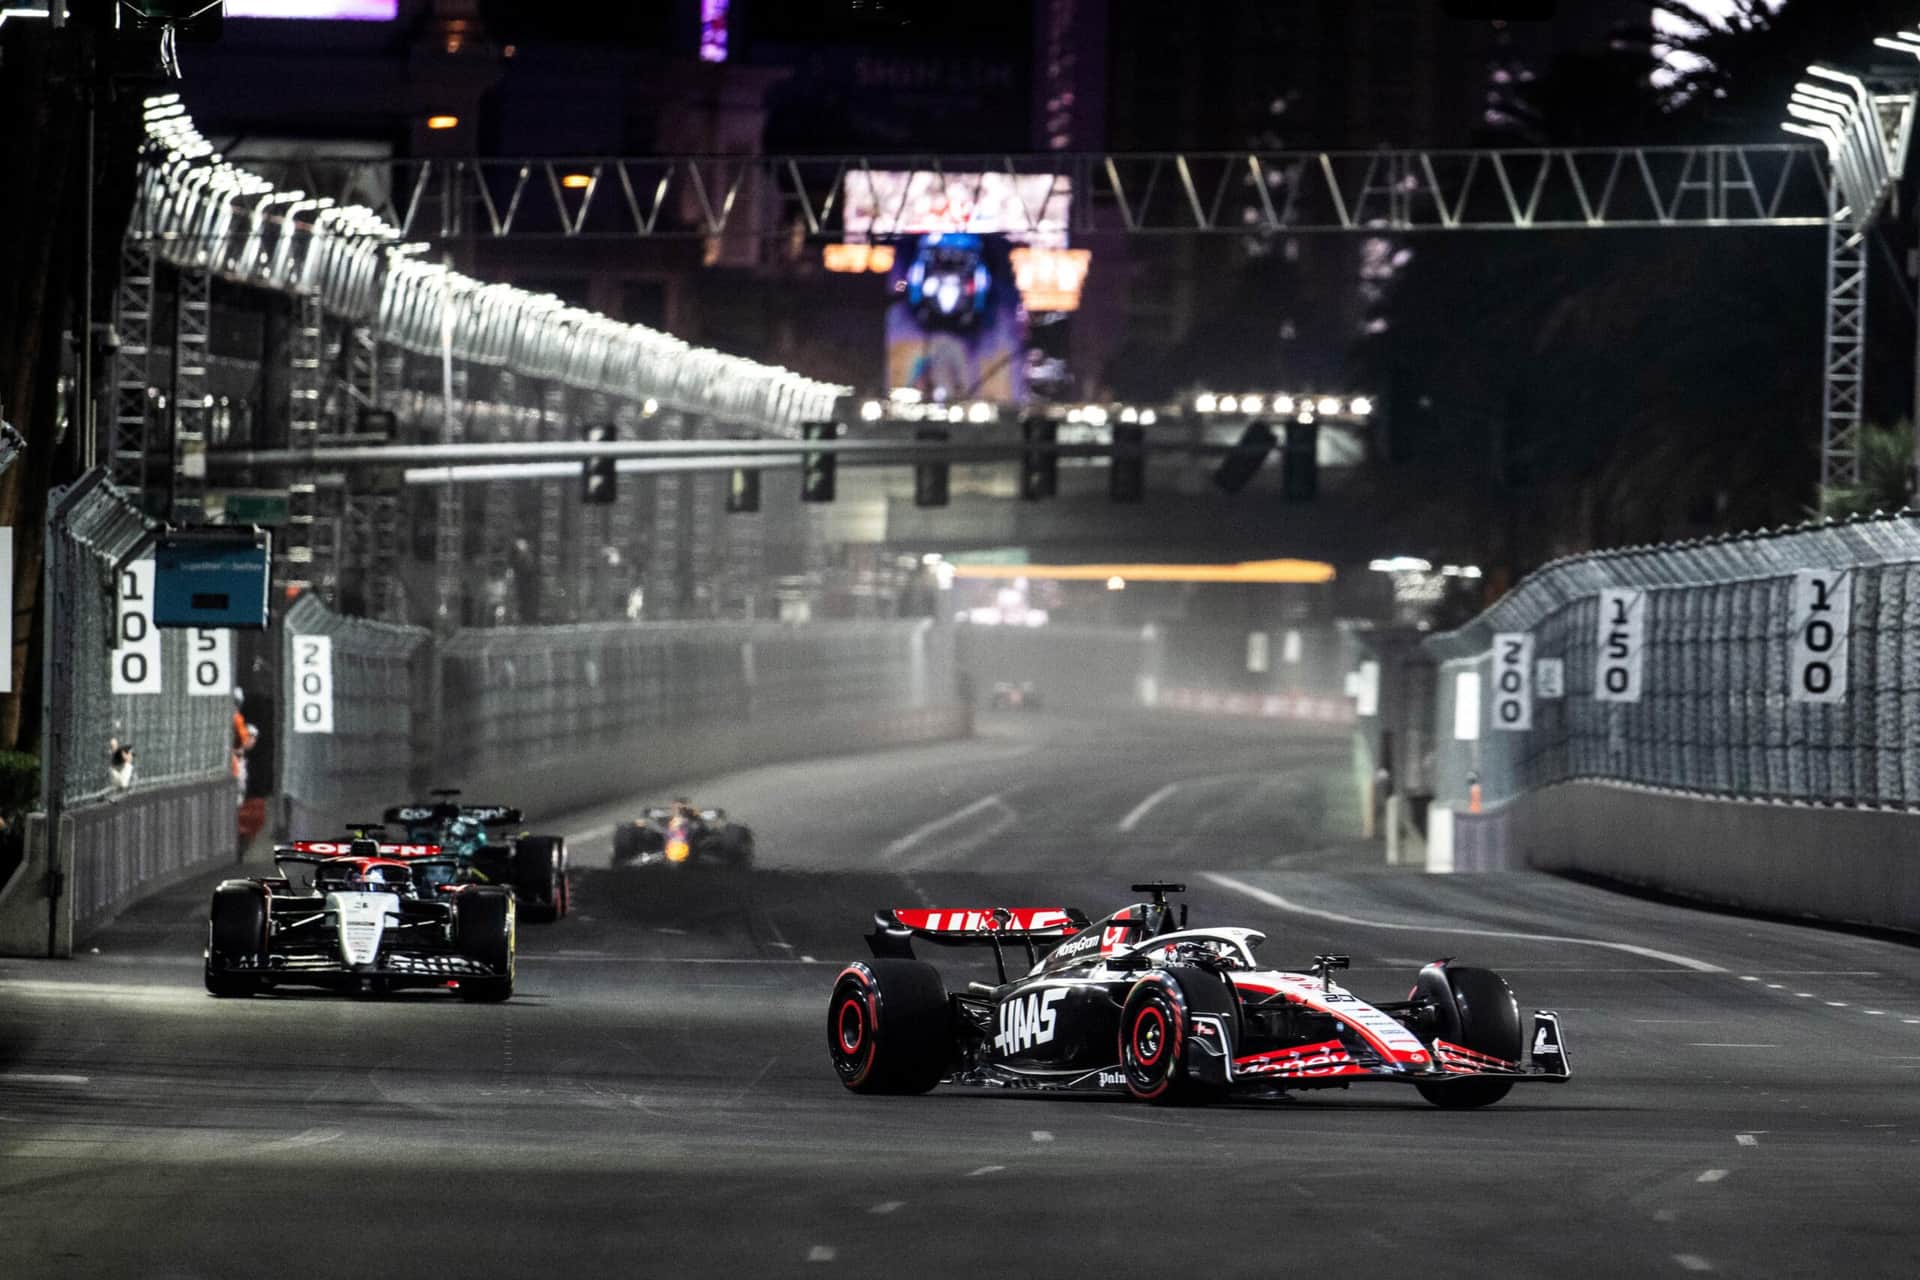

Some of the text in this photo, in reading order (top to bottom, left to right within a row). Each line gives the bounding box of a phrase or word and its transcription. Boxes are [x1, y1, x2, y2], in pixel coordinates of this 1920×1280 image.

[121, 570, 147, 683] 100
[196, 627, 218, 686] 50
[1604, 598, 1629, 694] 150
[1803, 579, 1833, 694] 100
[302, 643, 322, 724] 200
[1501, 641, 1522, 723] 200
[309, 843, 427, 855] OREN
[994, 988, 1071, 1056] HAAS
